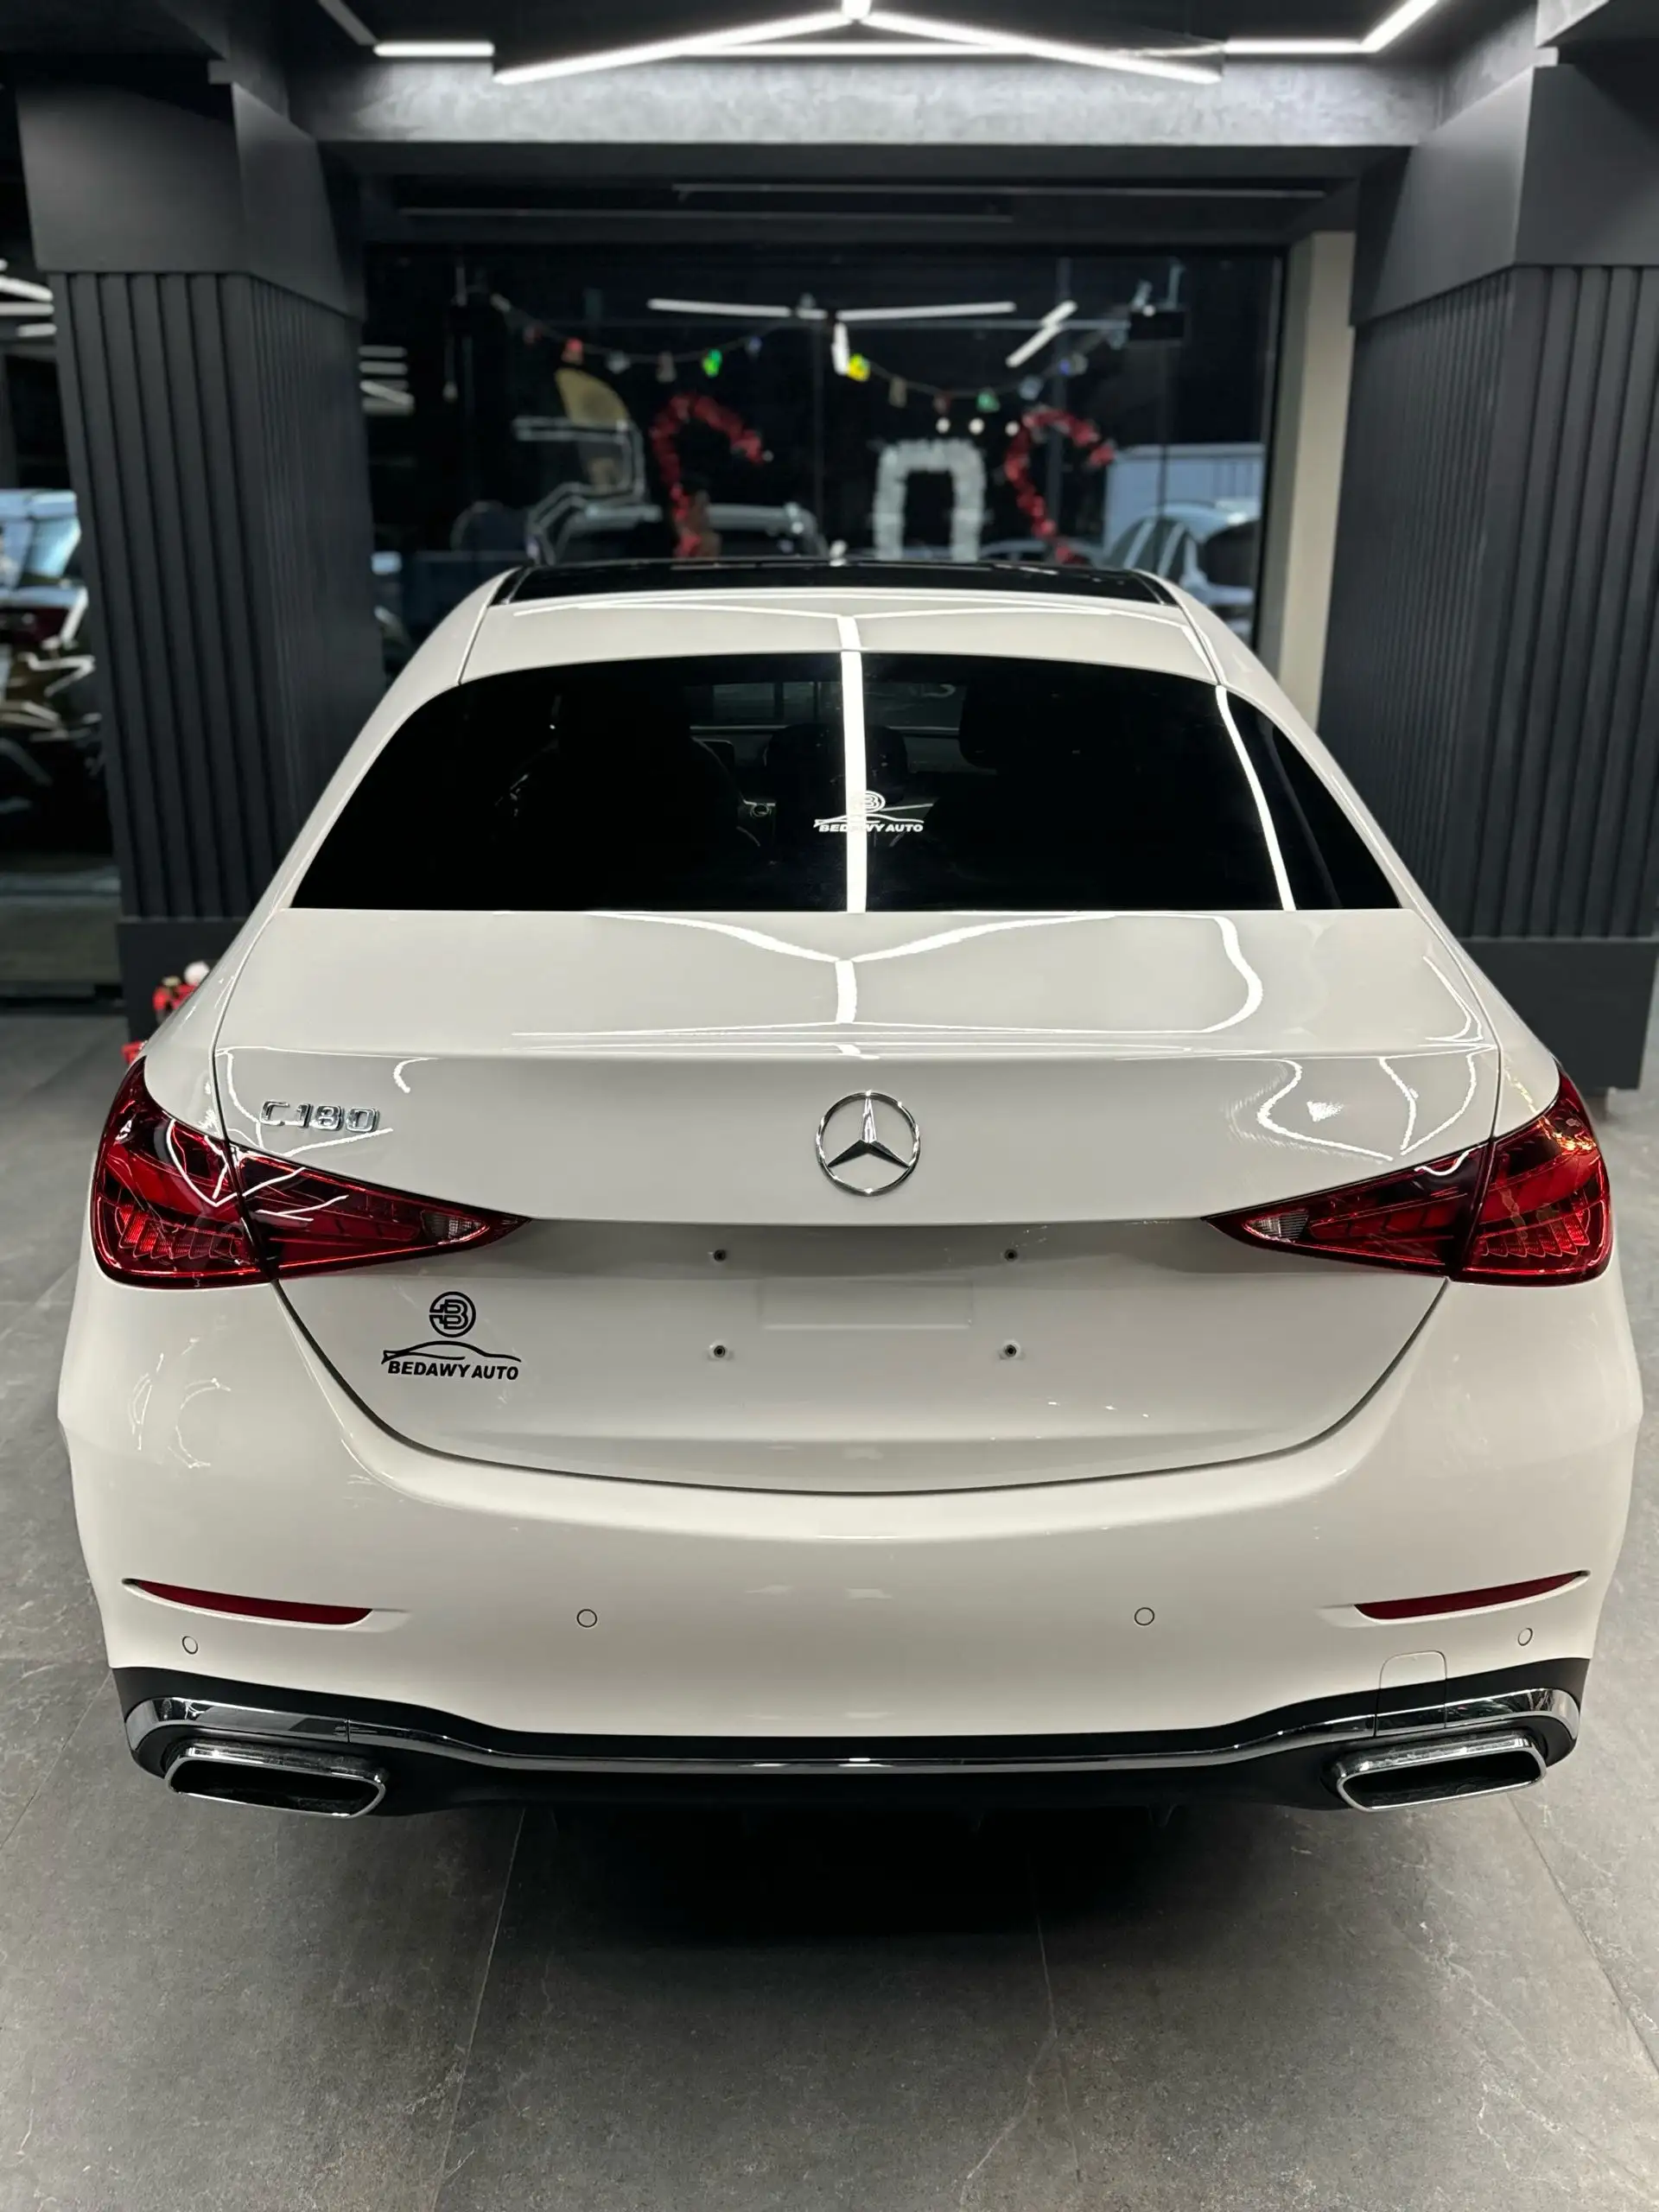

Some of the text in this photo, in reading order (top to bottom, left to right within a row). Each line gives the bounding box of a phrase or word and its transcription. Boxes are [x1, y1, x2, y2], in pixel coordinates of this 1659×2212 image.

[819, 823, 924, 832] BEDWY AUTO
[388, 1361, 518, 1380] BEDAWY AUTO
